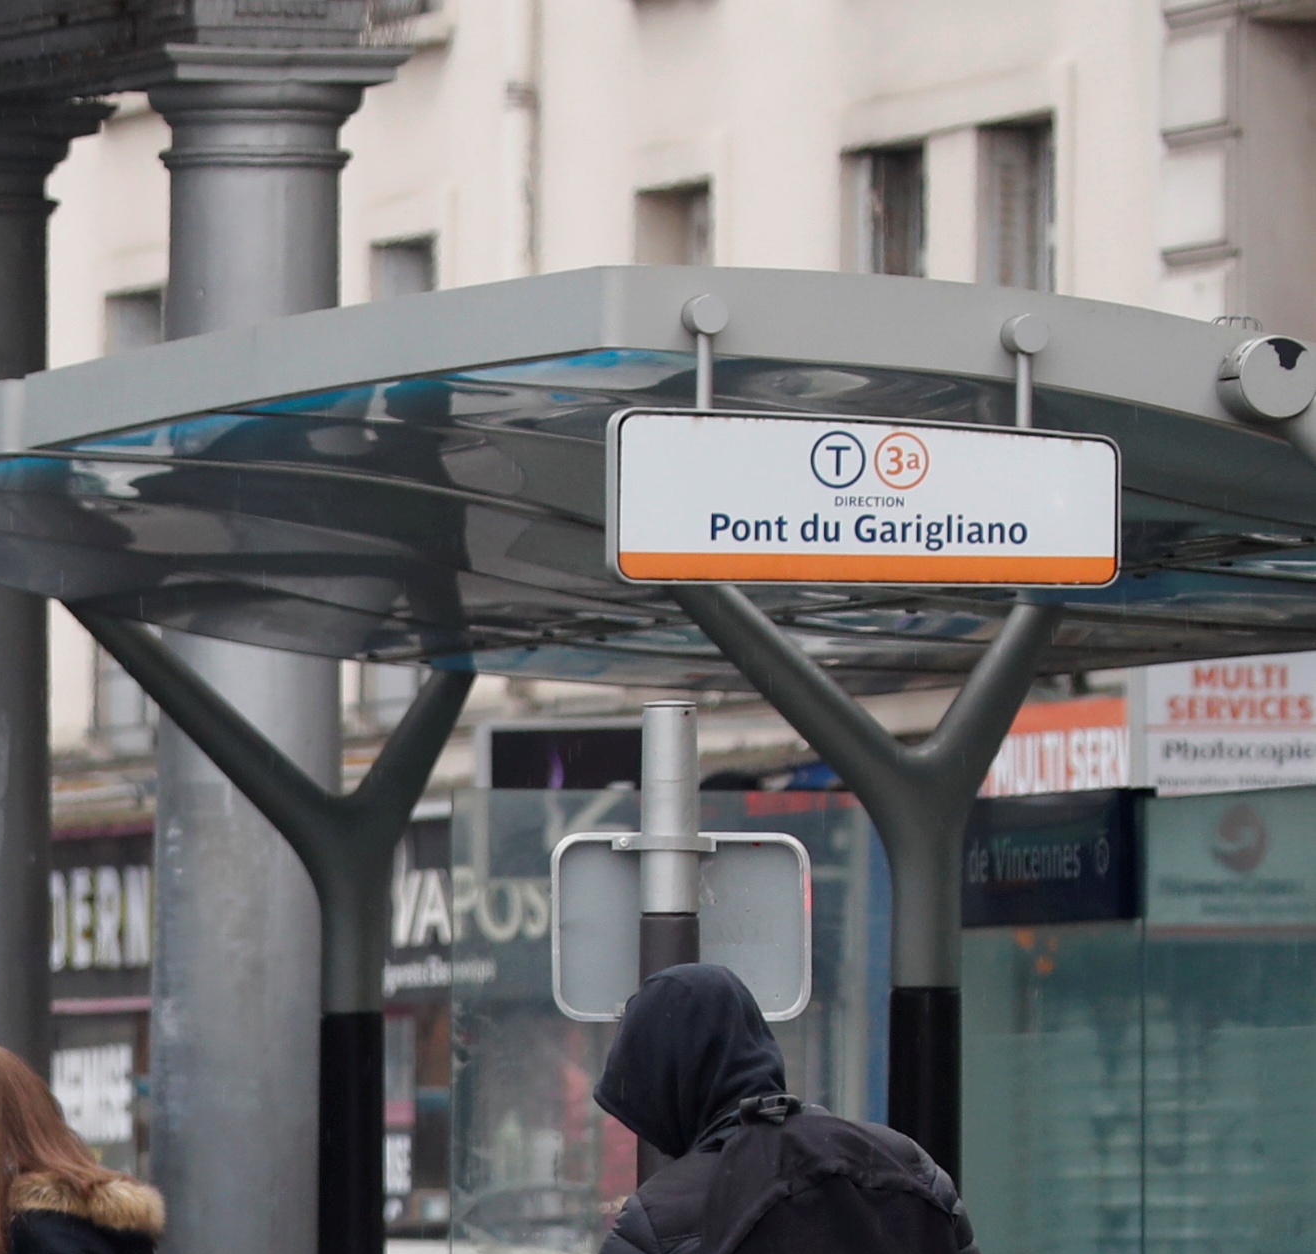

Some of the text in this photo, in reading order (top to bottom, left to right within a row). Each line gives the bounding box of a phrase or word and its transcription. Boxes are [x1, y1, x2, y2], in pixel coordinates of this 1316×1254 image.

[825, 445, 921, 477] T 3a
[834, 495, 905, 507] DIRECTION
[710, 513, 1028, 551] Pont du Garigliano
[1192, 663, 1289, 691] MULTI
[1167, 693, 1315, 721] SERVICES
[993, 838, 1082, 881] Vincennes
